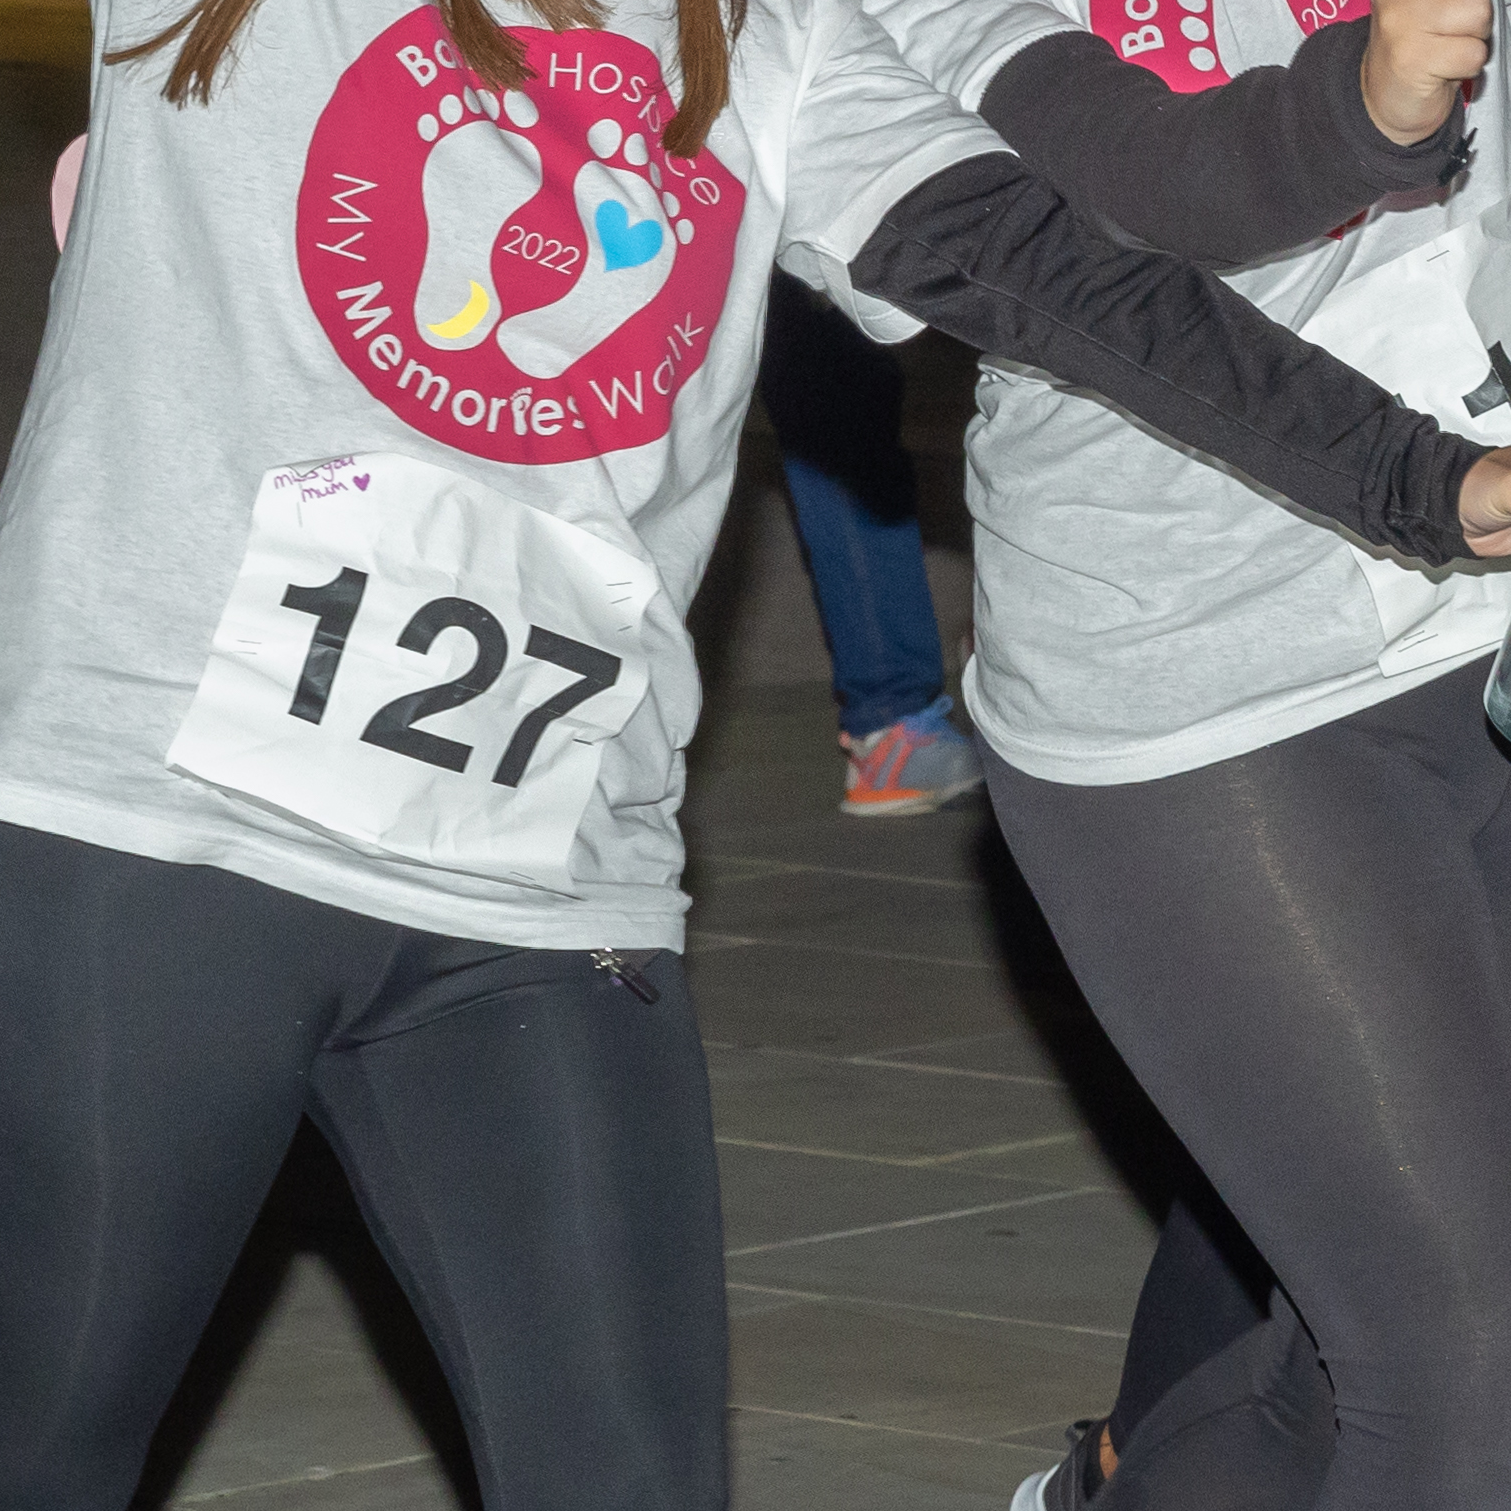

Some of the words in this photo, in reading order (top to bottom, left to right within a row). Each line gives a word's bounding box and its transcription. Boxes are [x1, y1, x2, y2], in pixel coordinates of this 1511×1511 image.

[547, 51, 721, 206] Hospce
[315, 172, 380, 262] My
[588, 312, 706, 420] Walk
[501, 225, 582, 276] 2022
[279, 565, 623, 789] 127
